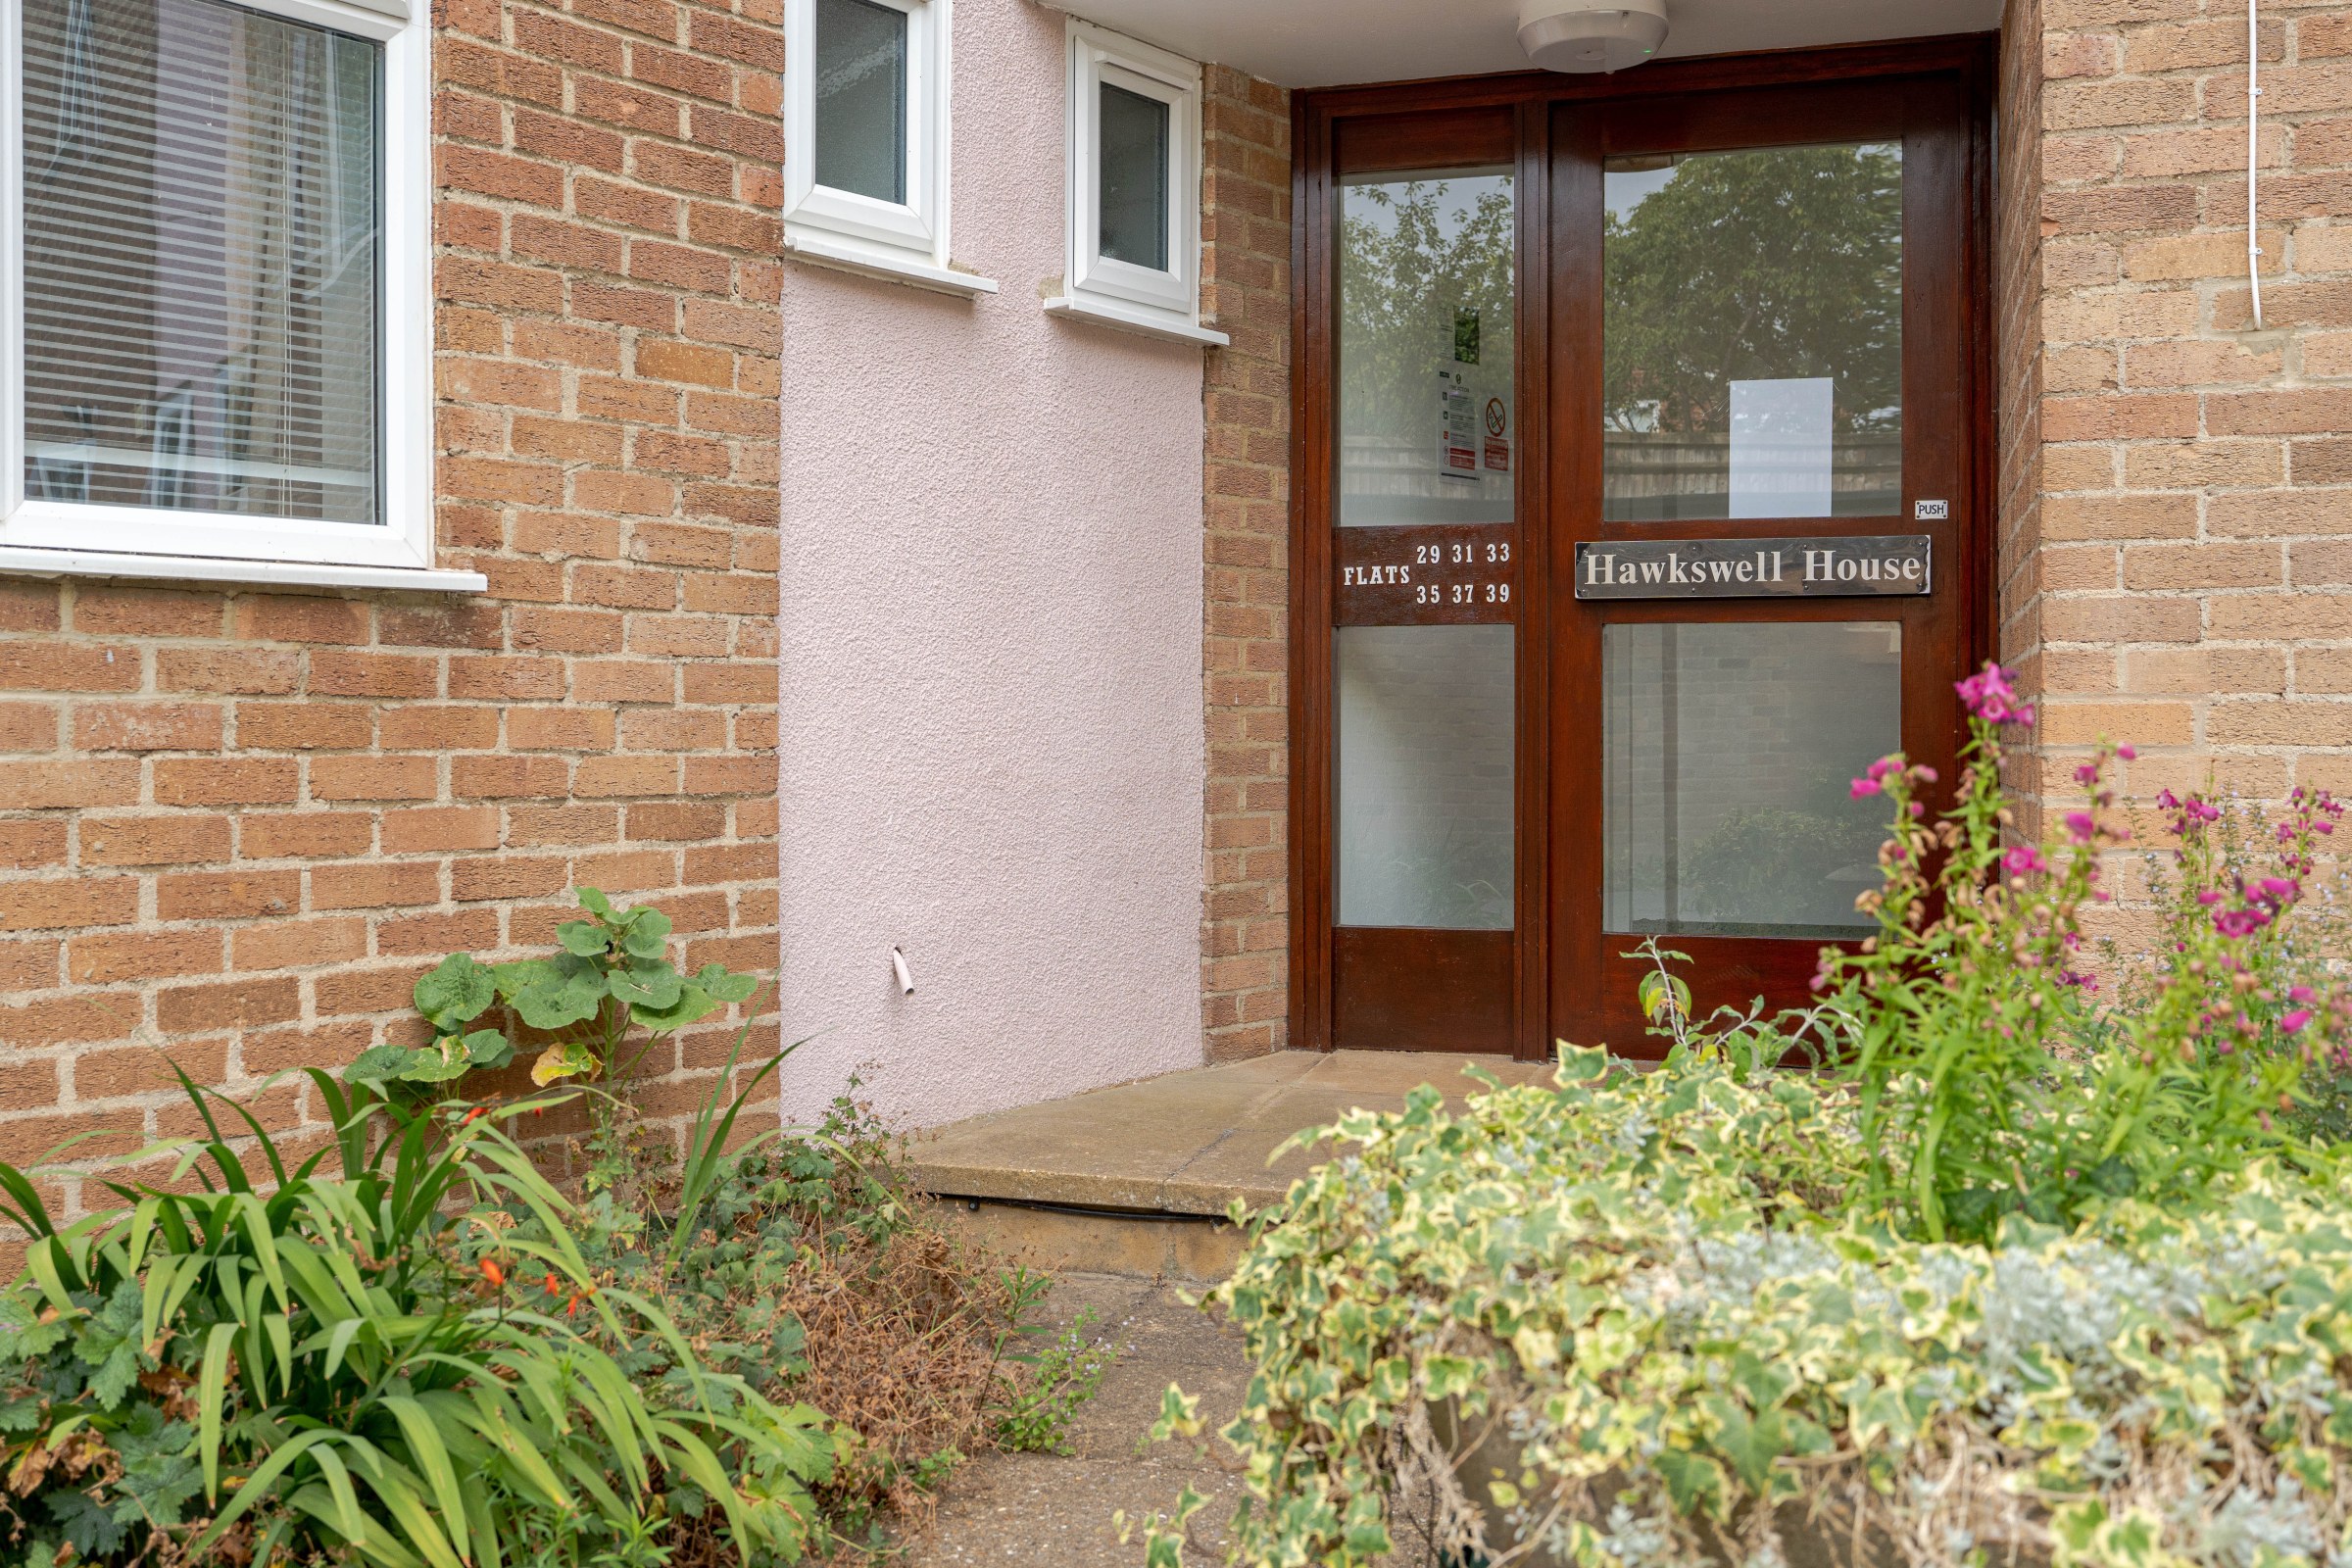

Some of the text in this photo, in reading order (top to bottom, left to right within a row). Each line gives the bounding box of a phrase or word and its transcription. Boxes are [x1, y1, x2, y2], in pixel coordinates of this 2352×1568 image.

[1918, 504, 1944, 514] PUSH
[1416, 543, 1510, 564] 29 31 33
[1344, 564, 1410, 586] FLATS
[1584, 550, 1921, 585] Hawkswell House
[1416, 583, 1510, 605] 35 37 39
